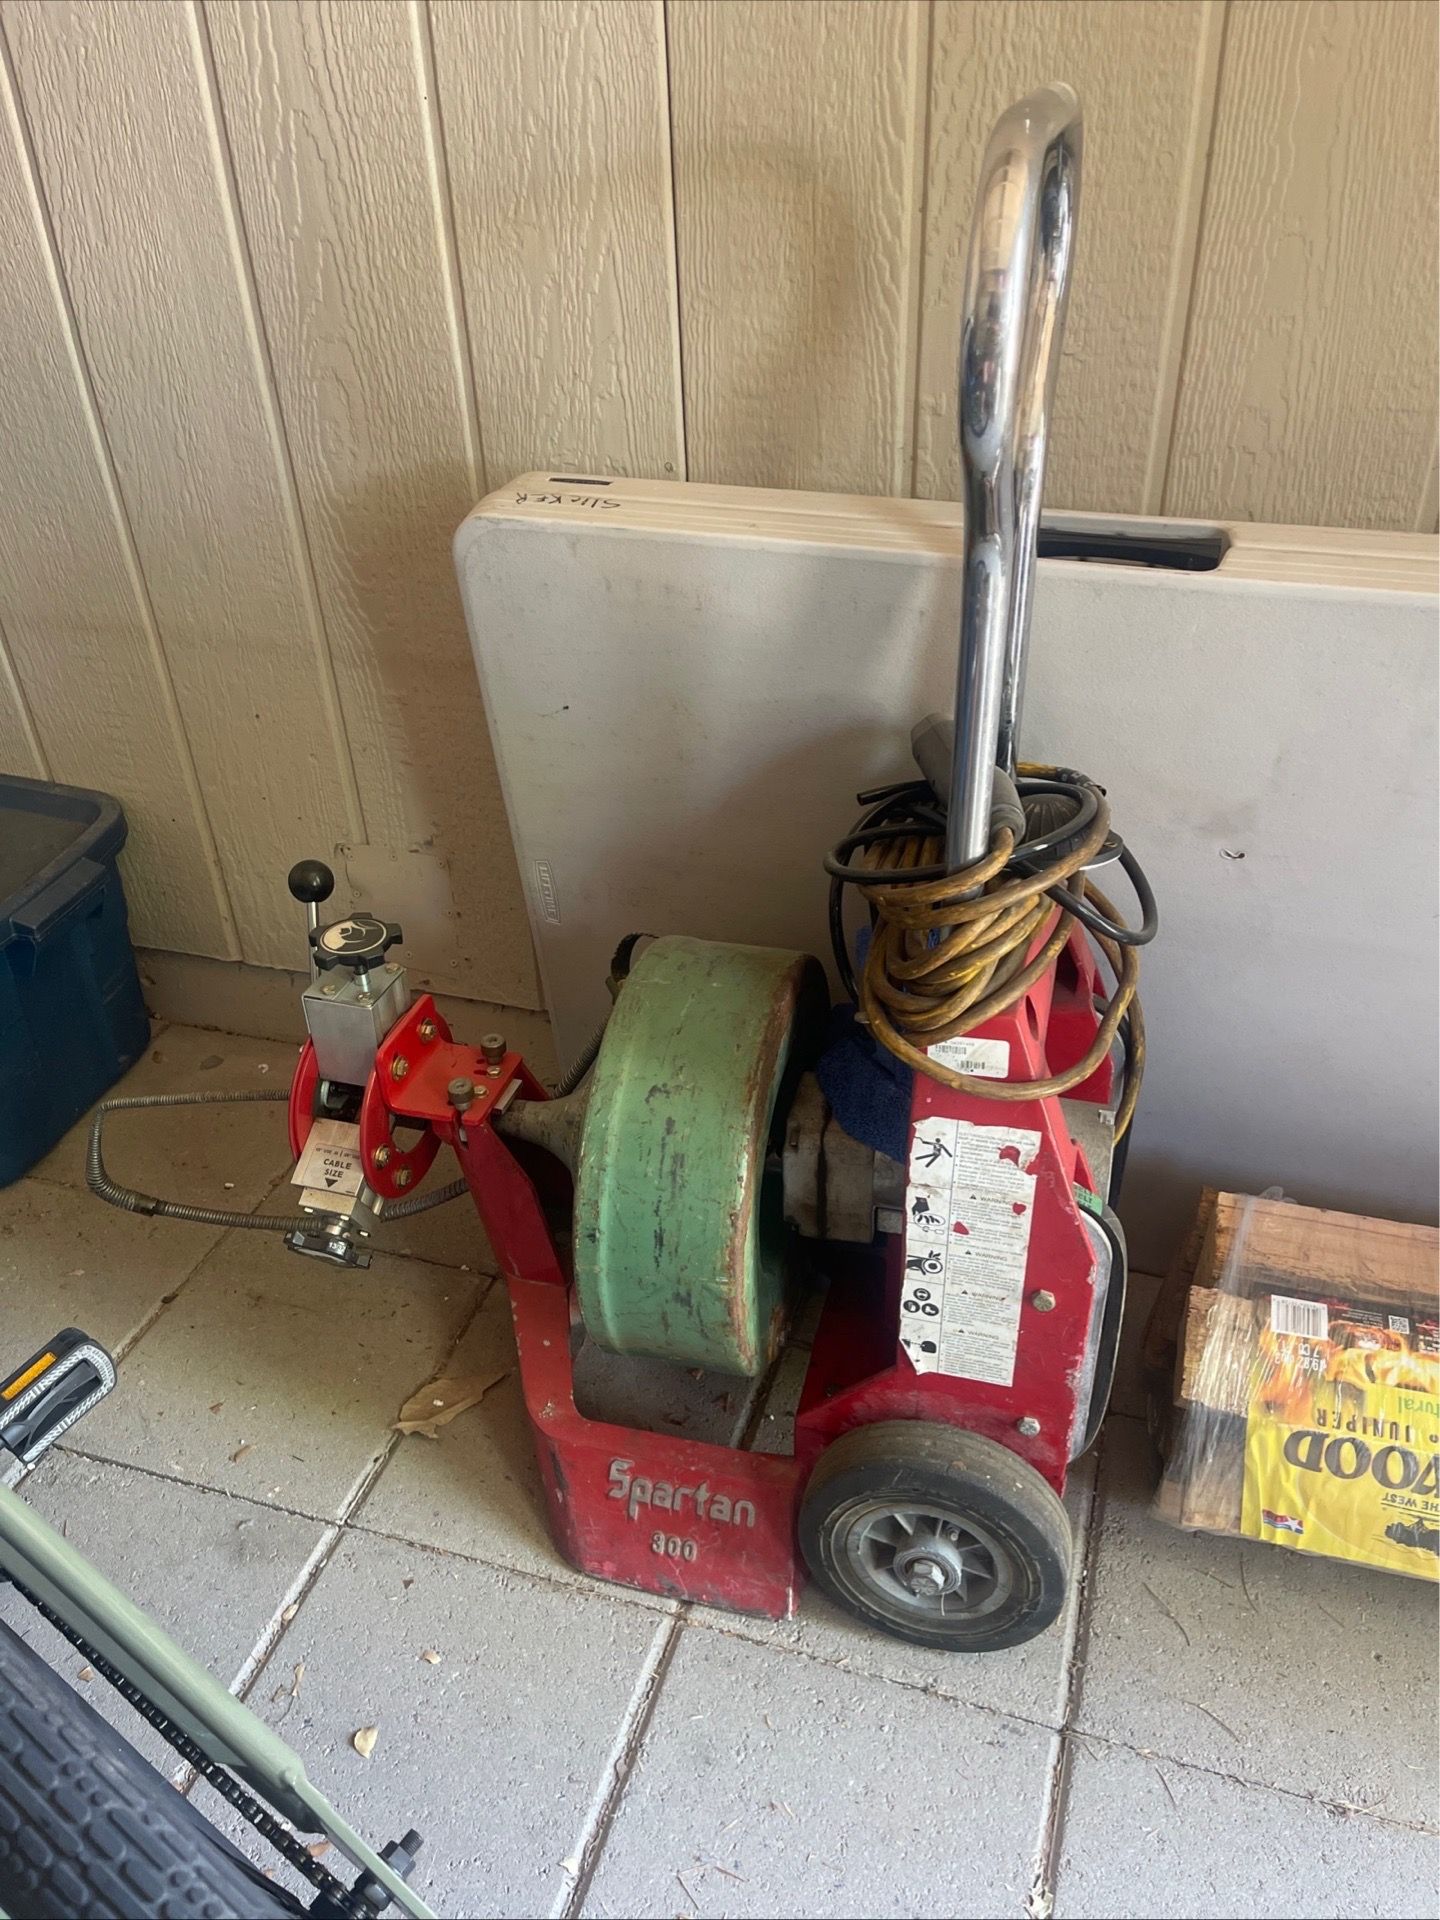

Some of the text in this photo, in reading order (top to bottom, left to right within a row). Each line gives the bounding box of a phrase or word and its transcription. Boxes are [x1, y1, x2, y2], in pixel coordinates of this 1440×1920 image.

[515, 492, 621, 509] SLICKER
[323, 1158, 352, 1170] CABLE
[324, 1168, 344, 1178] SIZE
[608, 1456, 756, 1527] Spartan
[1382, 1492, 1440, 1513] HE WEST
[652, 1530, 698, 1562] 300
